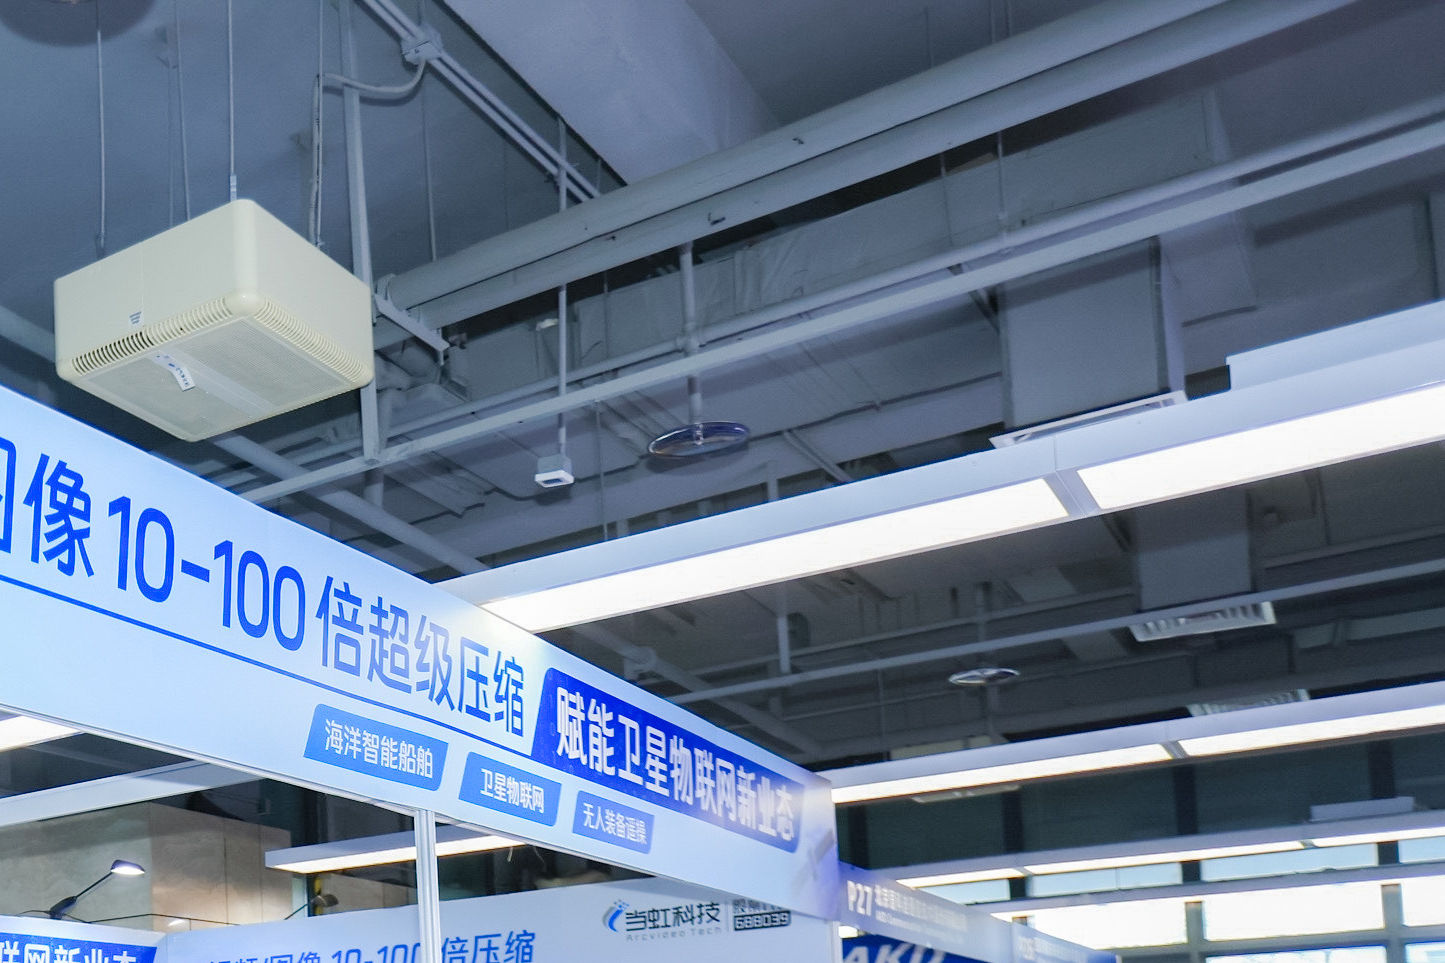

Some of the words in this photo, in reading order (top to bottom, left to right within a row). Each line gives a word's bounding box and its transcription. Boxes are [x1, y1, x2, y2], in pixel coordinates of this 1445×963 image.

[108, 496, 306, 651] 10-100
[315, 575, 525, 738] 倍超级压缩
[325, 718, 433, 779] 海洋智能船舶
[556, 687, 795, 842] 赋能卫星物联网新业态
[480, 768, 545, 814] 卫星物联网
[583, 802, 647, 845] 无人装备遥操
[625, 902, 721, 931] 当虹科技
[847, 880, 872, 917] P27
